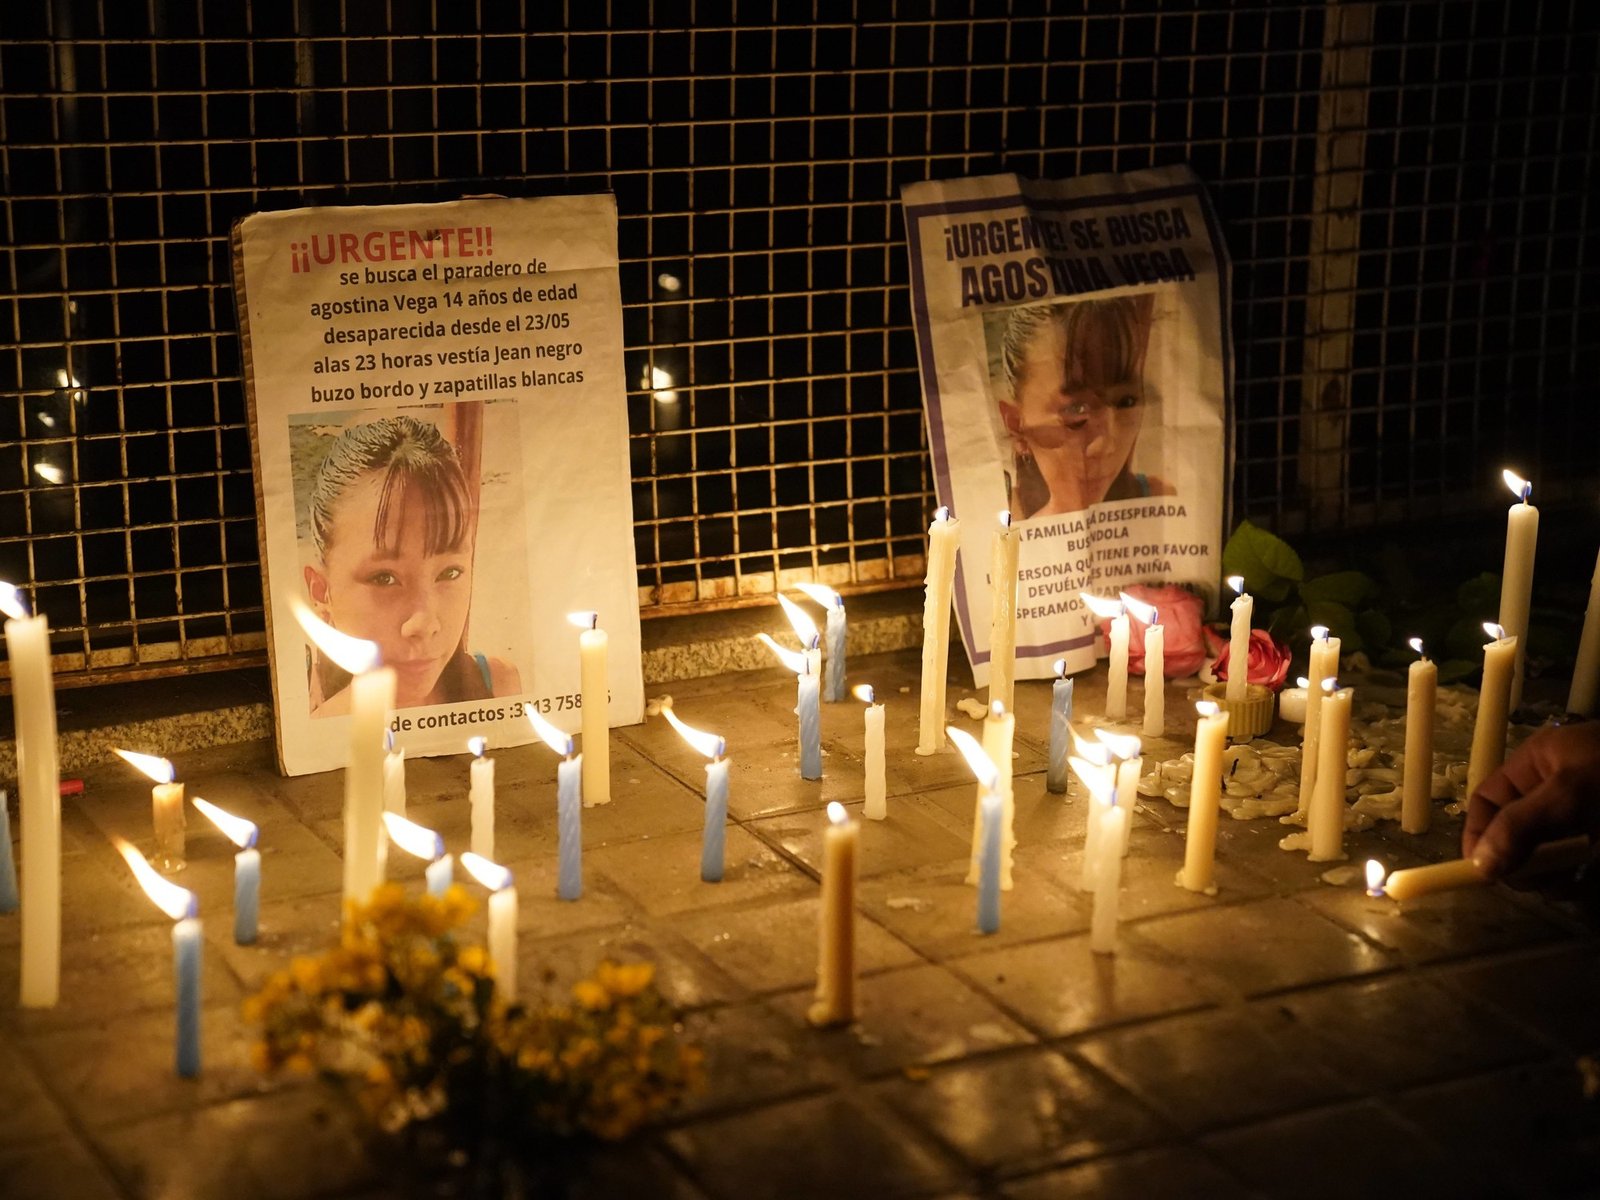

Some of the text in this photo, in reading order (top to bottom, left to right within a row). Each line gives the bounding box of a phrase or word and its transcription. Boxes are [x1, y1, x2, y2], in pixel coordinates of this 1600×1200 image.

[1069, 218, 1104, 250] SE
[1106, 207, 1192, 246] BUSCA
[290, 226, 493, 273] ¡¡URGENTE!!
[340, 258, 547, 285] se busca el paradero de
[961, 247, 1196, 308] AGOSTINA VEGA
[310, 283, 578, 320] agostina Vega 14 años de edad
[323, 312, 570, 345] desaparecida desde el 23/05
[313, 341, 583, 374] alas 23 horas vestía Jean negro
[311, 368, 584, 403] buzo bordo y zapatillas blancas
[1026, 520, 1084, 542] FAMILIA
[1099, 504, 1187, 524] DESESPERADA
[1018, 562, 1072, 581] ERSONA
[1096, 545, 1130, 563] TIENE
[1133, 544, 1159, 557] POR
[1163, 543, 1209, 557] FAVOR
[1104, 562, 1132, 577] UNA
[1136, 558, 1172, 575] NIÑA
[1017, 599, 1085, 619] SPERAMOS
[390, 716, 412, 733] de
[417, 706, 505, 729] contactos
